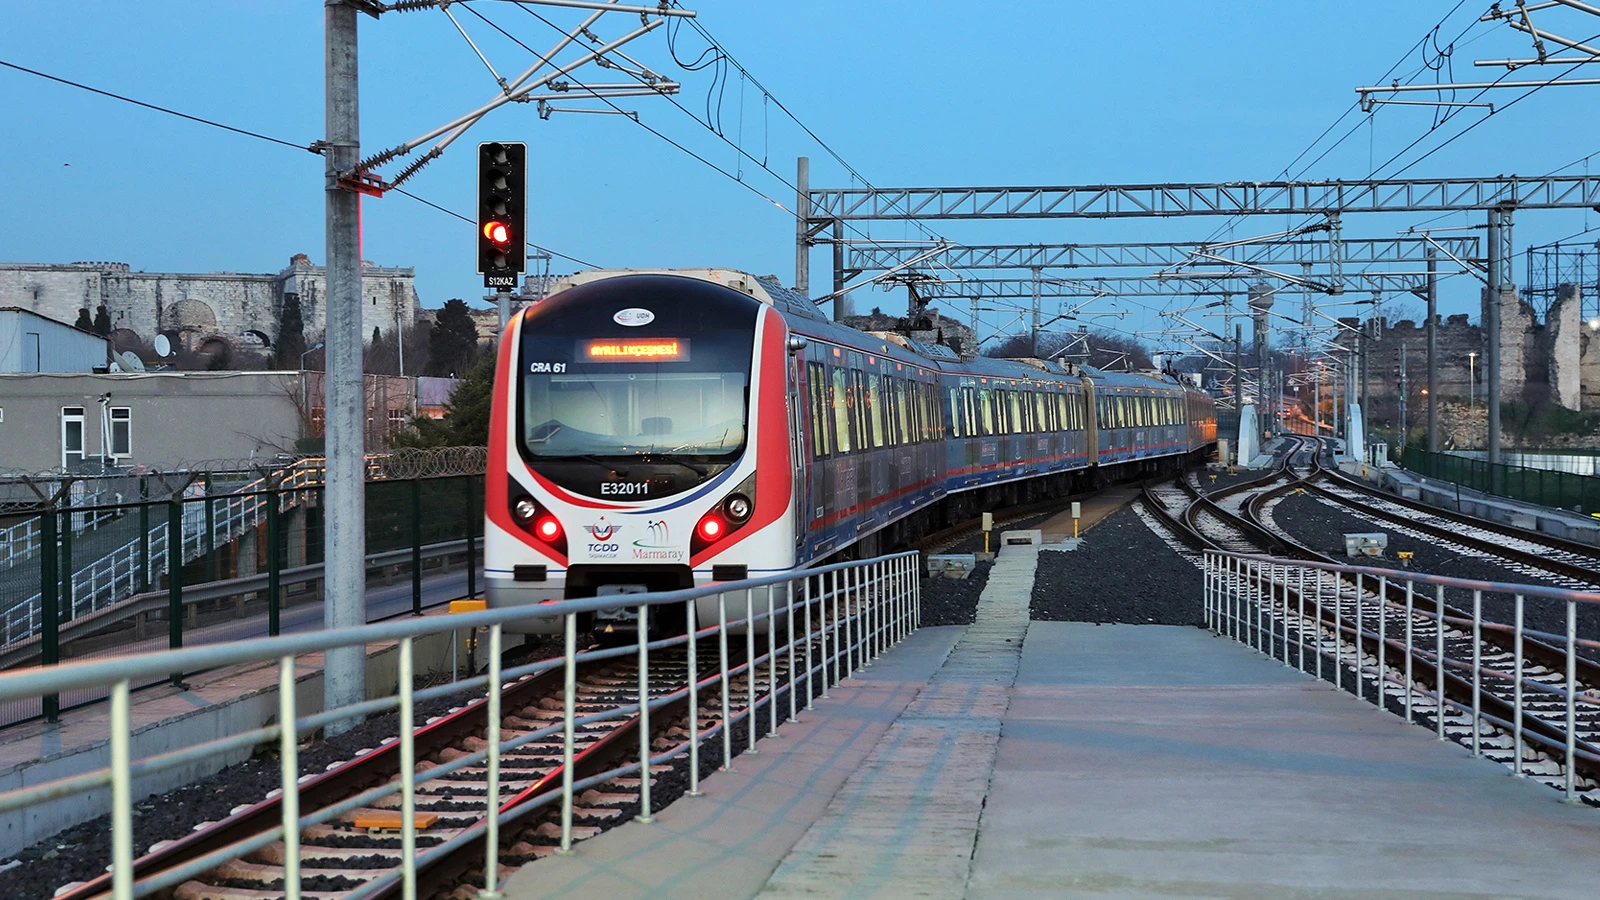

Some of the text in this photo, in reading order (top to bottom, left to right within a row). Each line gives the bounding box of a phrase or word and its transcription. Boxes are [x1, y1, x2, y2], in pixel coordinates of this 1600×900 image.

[488, 277, 514, 286] S12KAZ
[530, 362, 567, 373] CRA 61
[601, 482, 648, 494] E32011
[588, 543, 619, 552] TCDD
[632, 548, 684, 561] Marmaray
